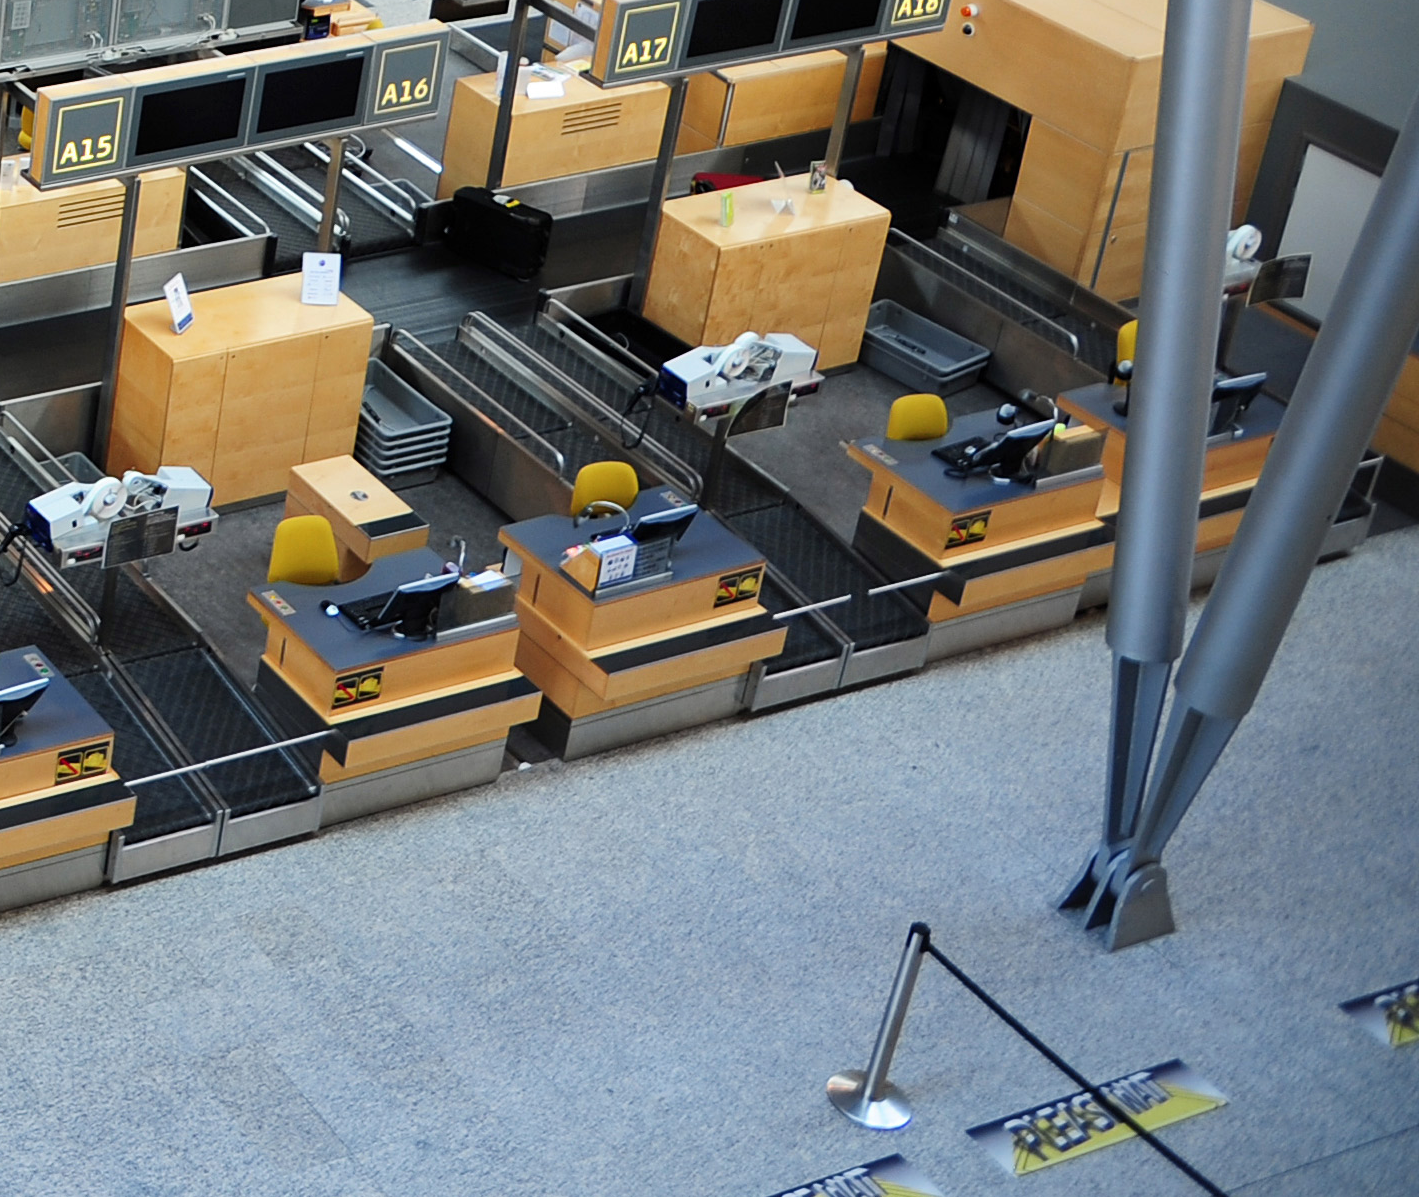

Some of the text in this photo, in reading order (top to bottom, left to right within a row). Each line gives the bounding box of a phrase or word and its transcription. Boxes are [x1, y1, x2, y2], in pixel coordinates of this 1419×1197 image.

[621, 37, 668, 67] A17
[381, 77, 429, 107] A16
[59, 134, 113, 166] A15
